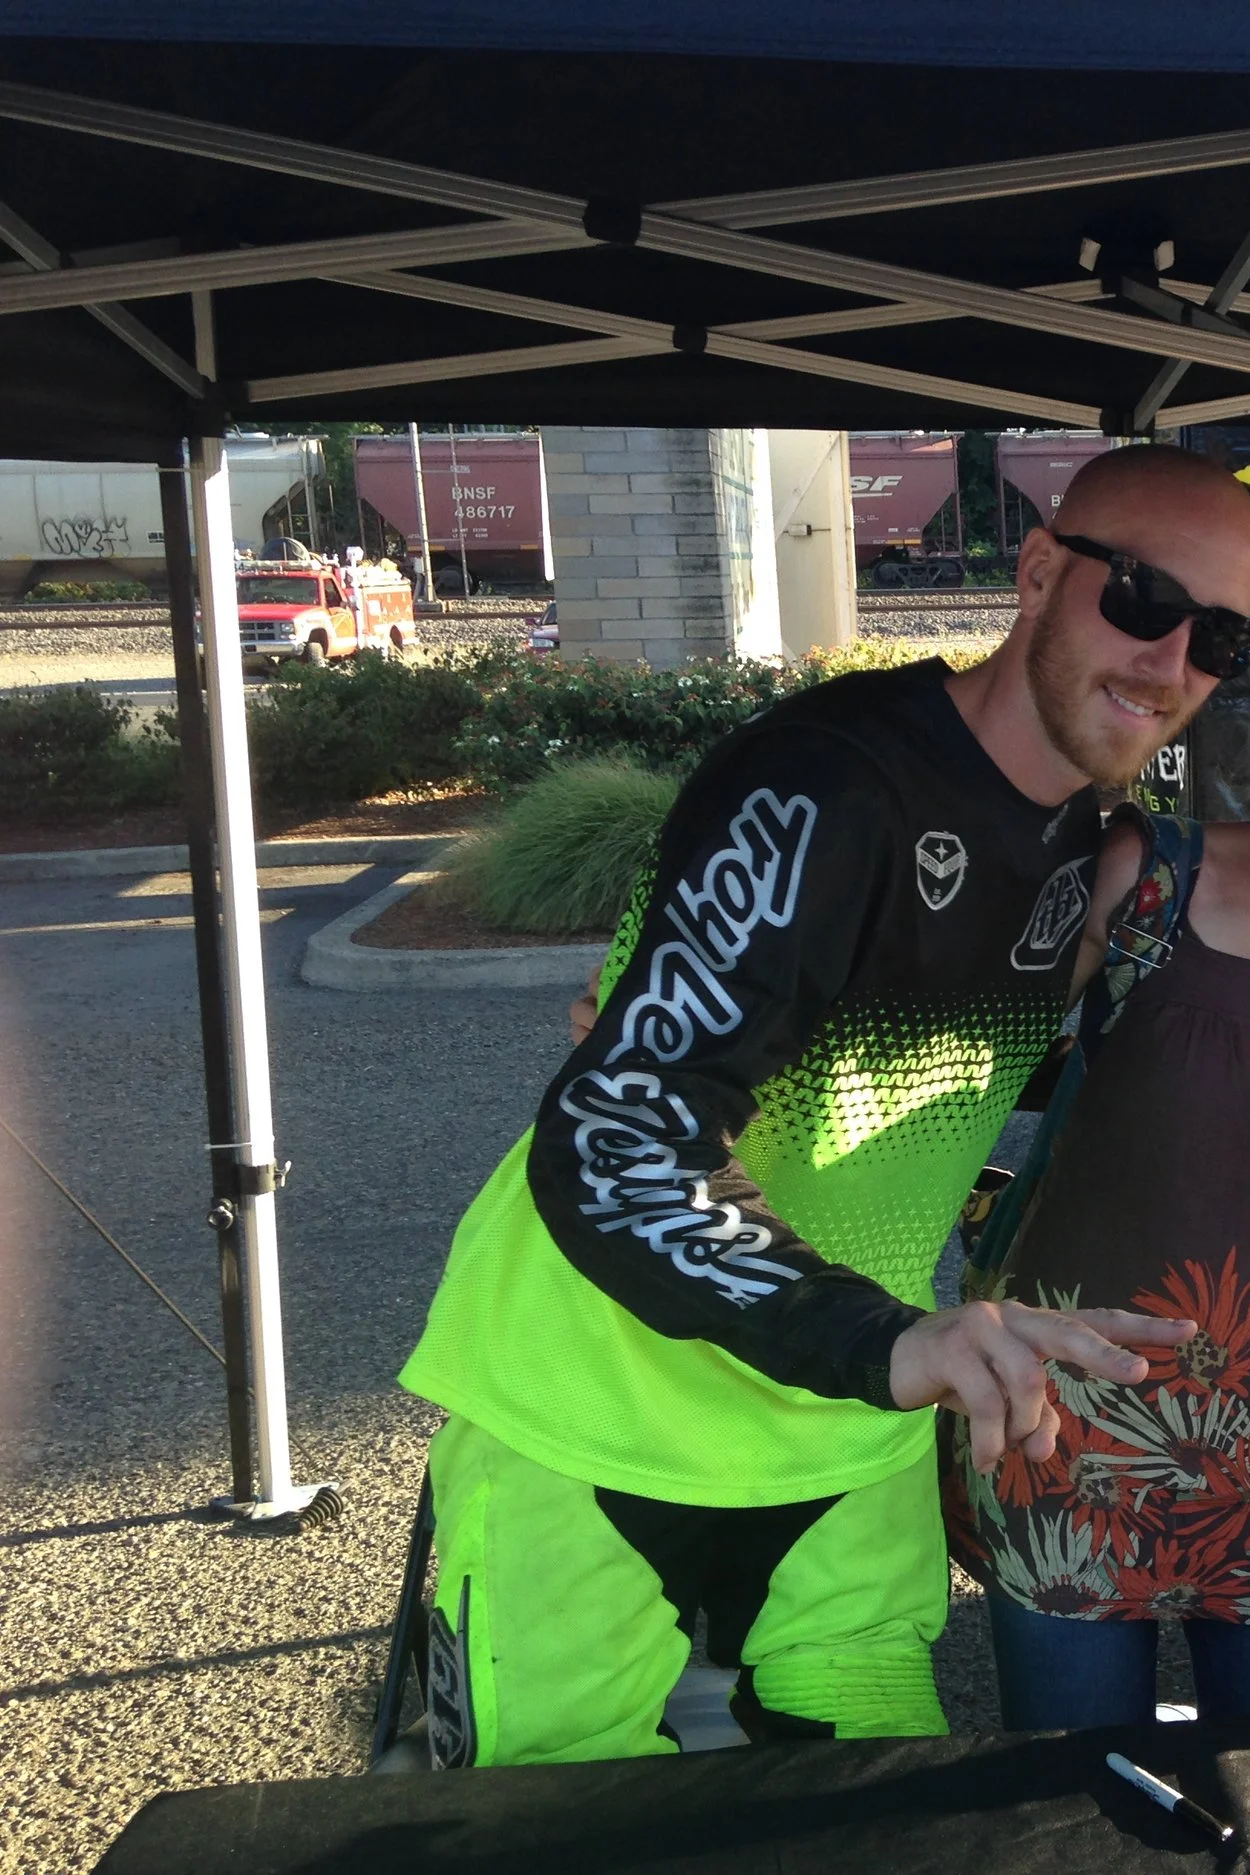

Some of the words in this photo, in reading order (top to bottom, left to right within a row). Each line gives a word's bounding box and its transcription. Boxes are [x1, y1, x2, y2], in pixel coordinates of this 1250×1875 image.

[850, 475, 902, 491] SF
[451, 487, 496, 500] BNSF
[454, 505, 515, 519] 486717
